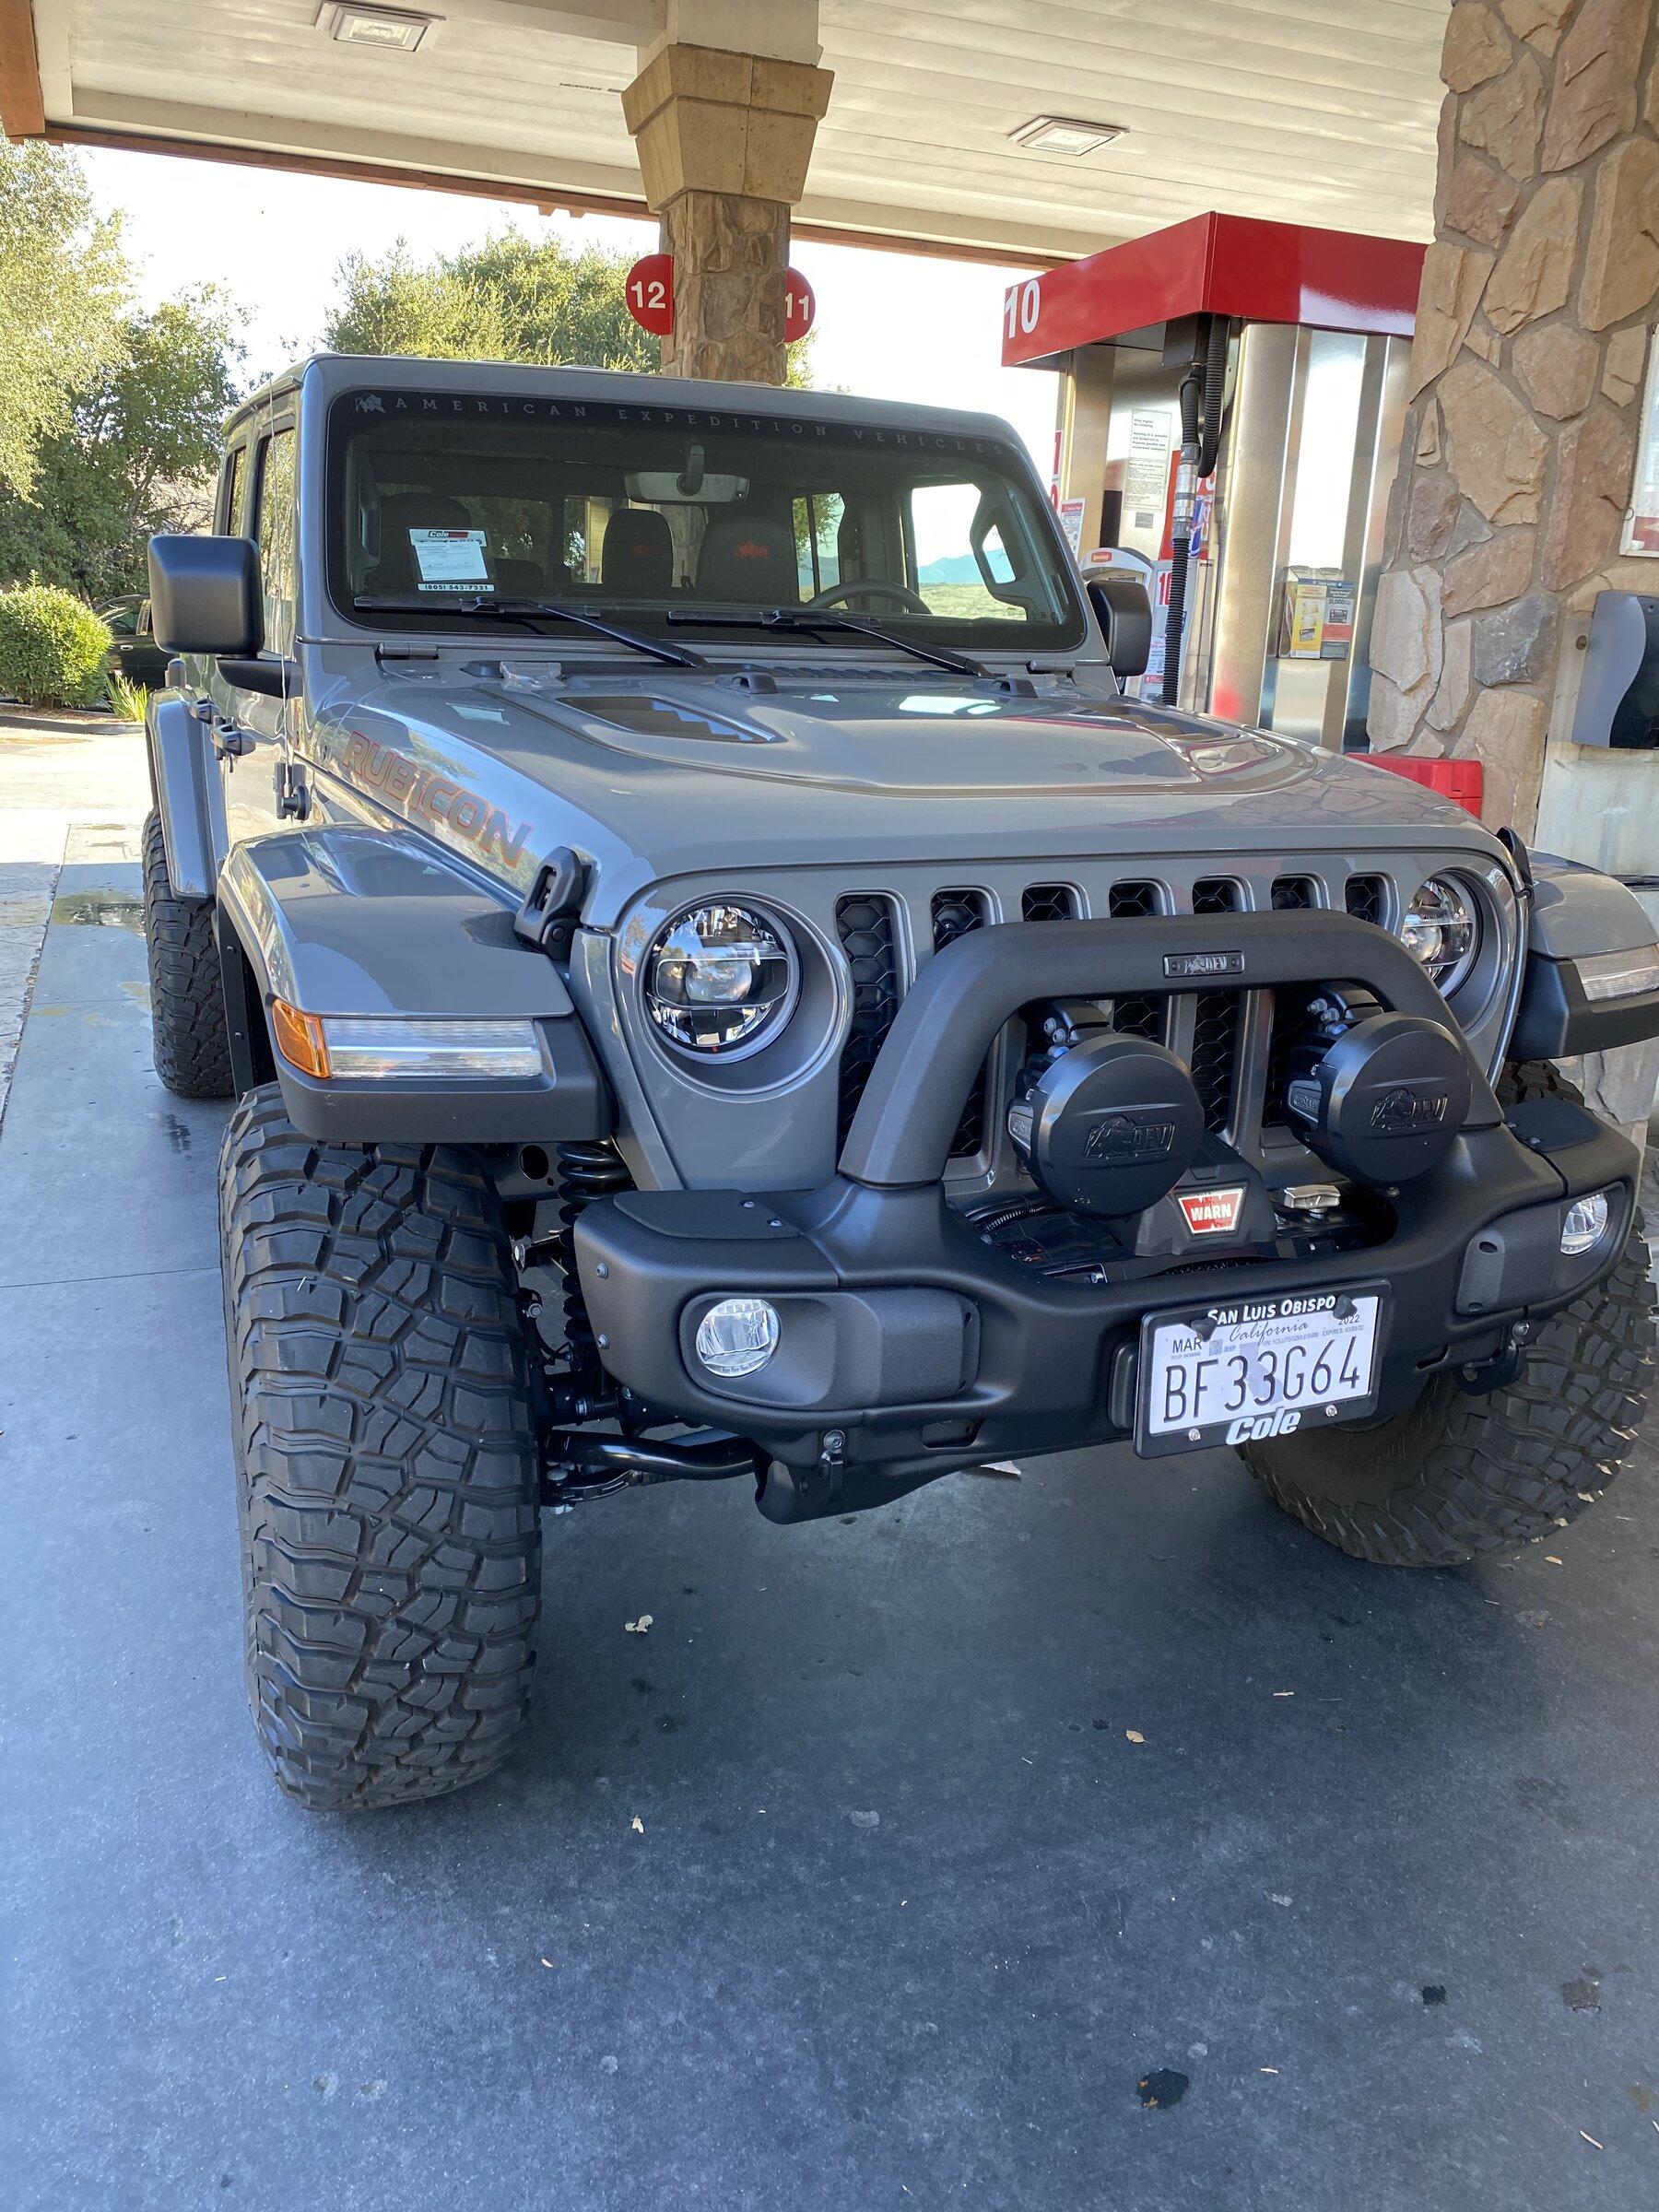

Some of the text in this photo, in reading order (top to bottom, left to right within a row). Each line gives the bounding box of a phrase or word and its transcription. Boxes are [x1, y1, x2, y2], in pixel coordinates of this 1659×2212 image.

[630, 281, 665, 309] 12
[785, 292, 809, 322] 11
[1006, 280, 1041, 338] 10
[395, 397, 1002, 455] AMERICAN EXPEDITION VEHICLES
[342, 731, 535, 869] RUBICON
[1191, 1203, 1231, 1222] WARN
[1207, 1295, 1335, 1325] SAN LUIS OBISPO
[1338, 1314, 1360, 1325] 2022
[1172, 1337, 1202, 1353] MAR
[1229, 1322, 1309, 1346] California
[1163, 1336, 1359, 1423] BF33G64
[1226, 1406, 1301, 1445] Cole
